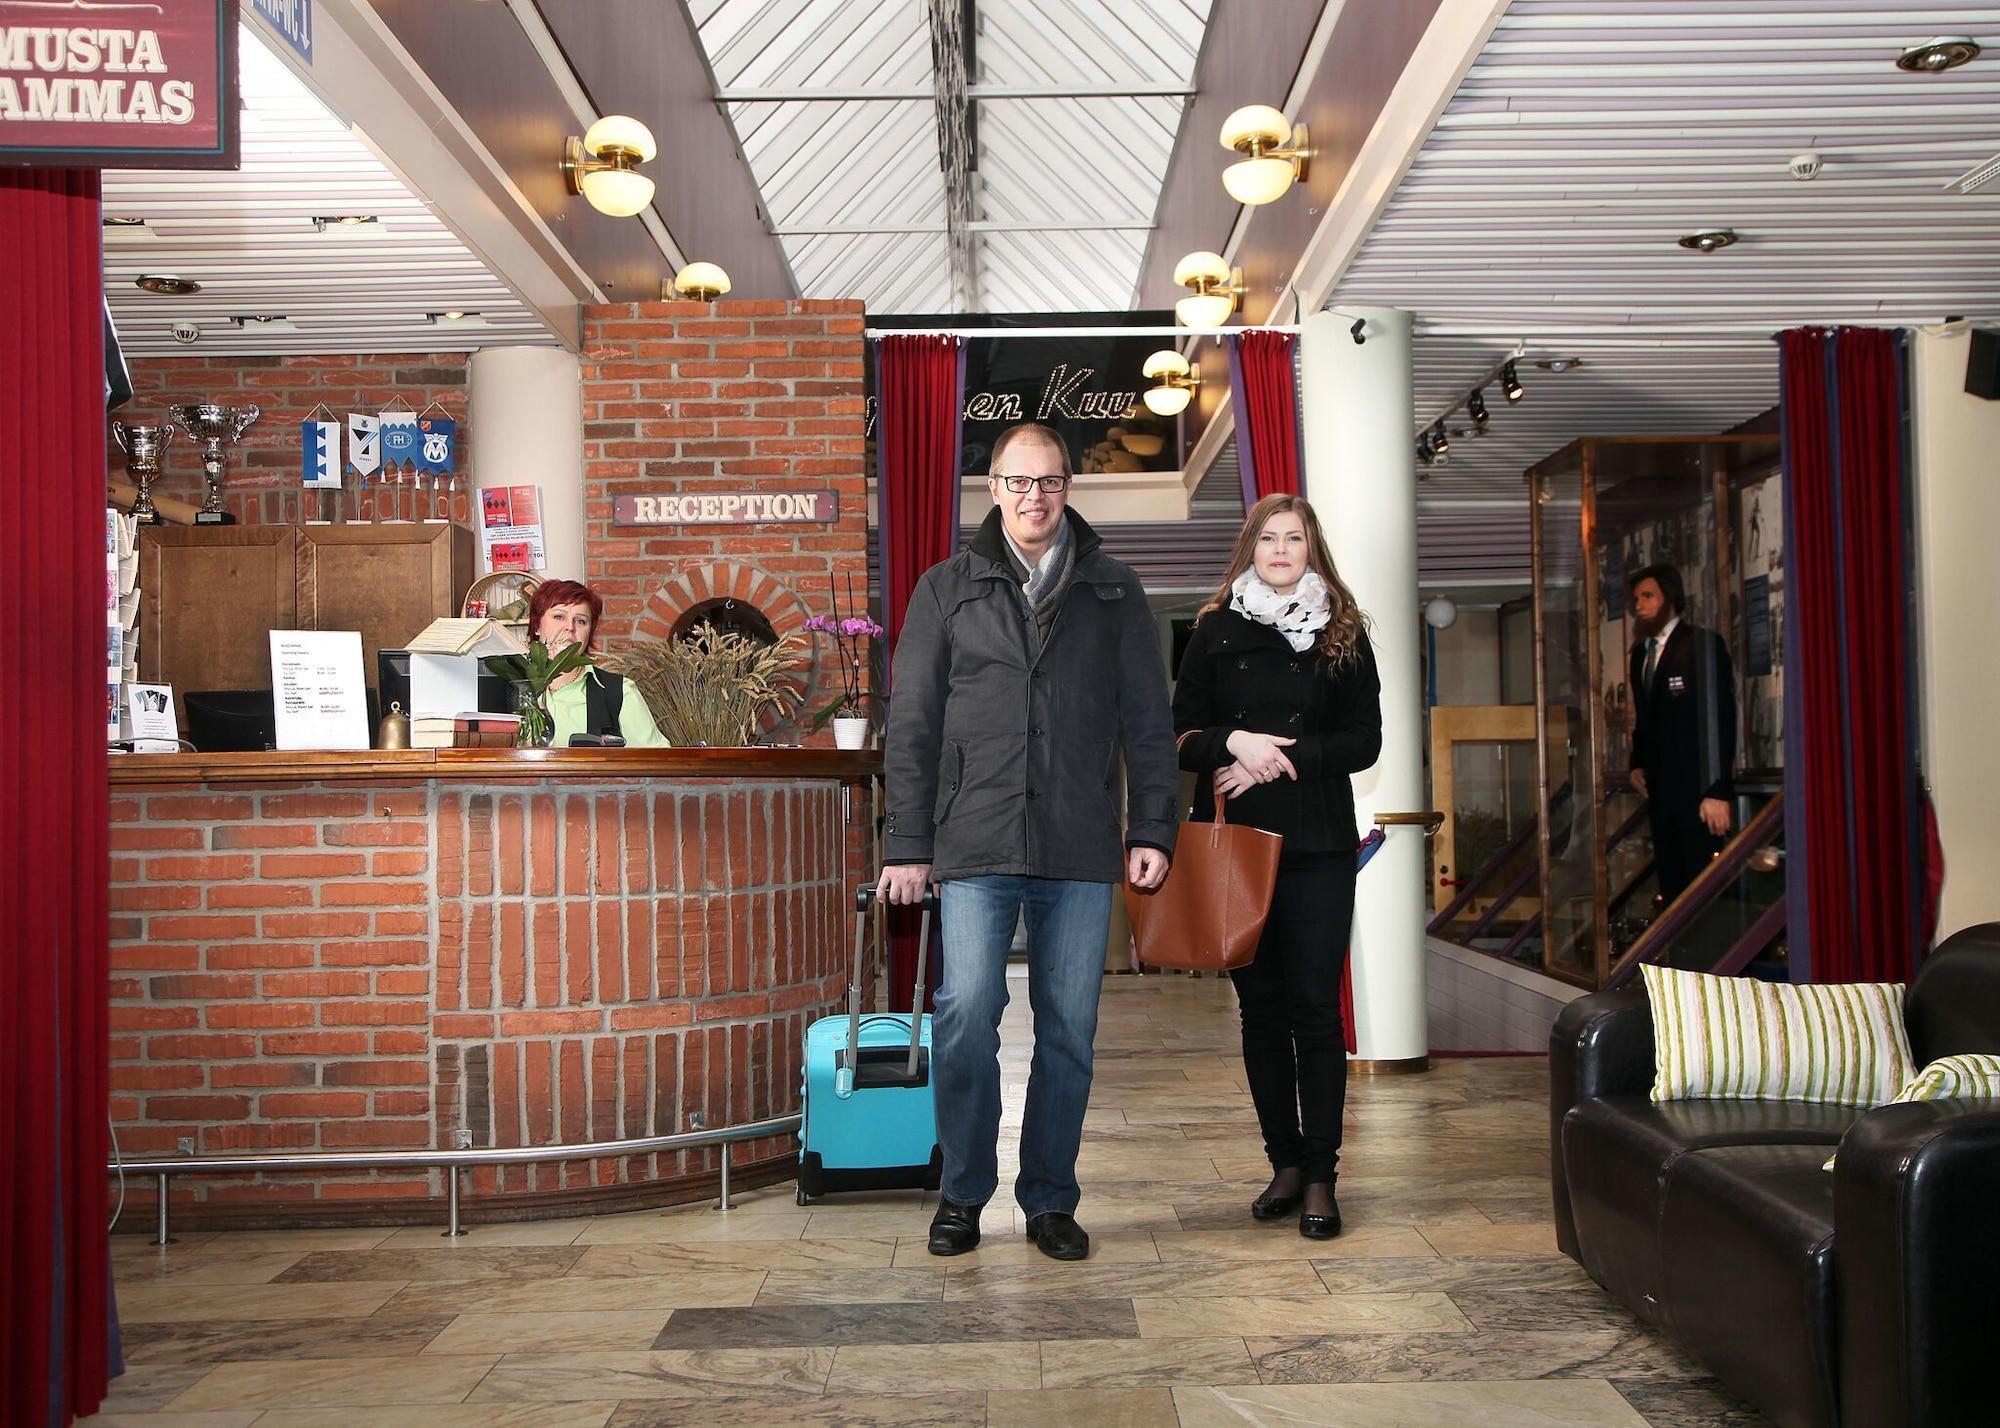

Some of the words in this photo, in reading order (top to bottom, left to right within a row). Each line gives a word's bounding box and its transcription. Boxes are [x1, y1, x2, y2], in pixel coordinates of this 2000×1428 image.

[0, 27, 167, 73] MUSTA
[1036, 363, 1137, 420] Kuu
[634, 494, 818, 522] RECEPTION
